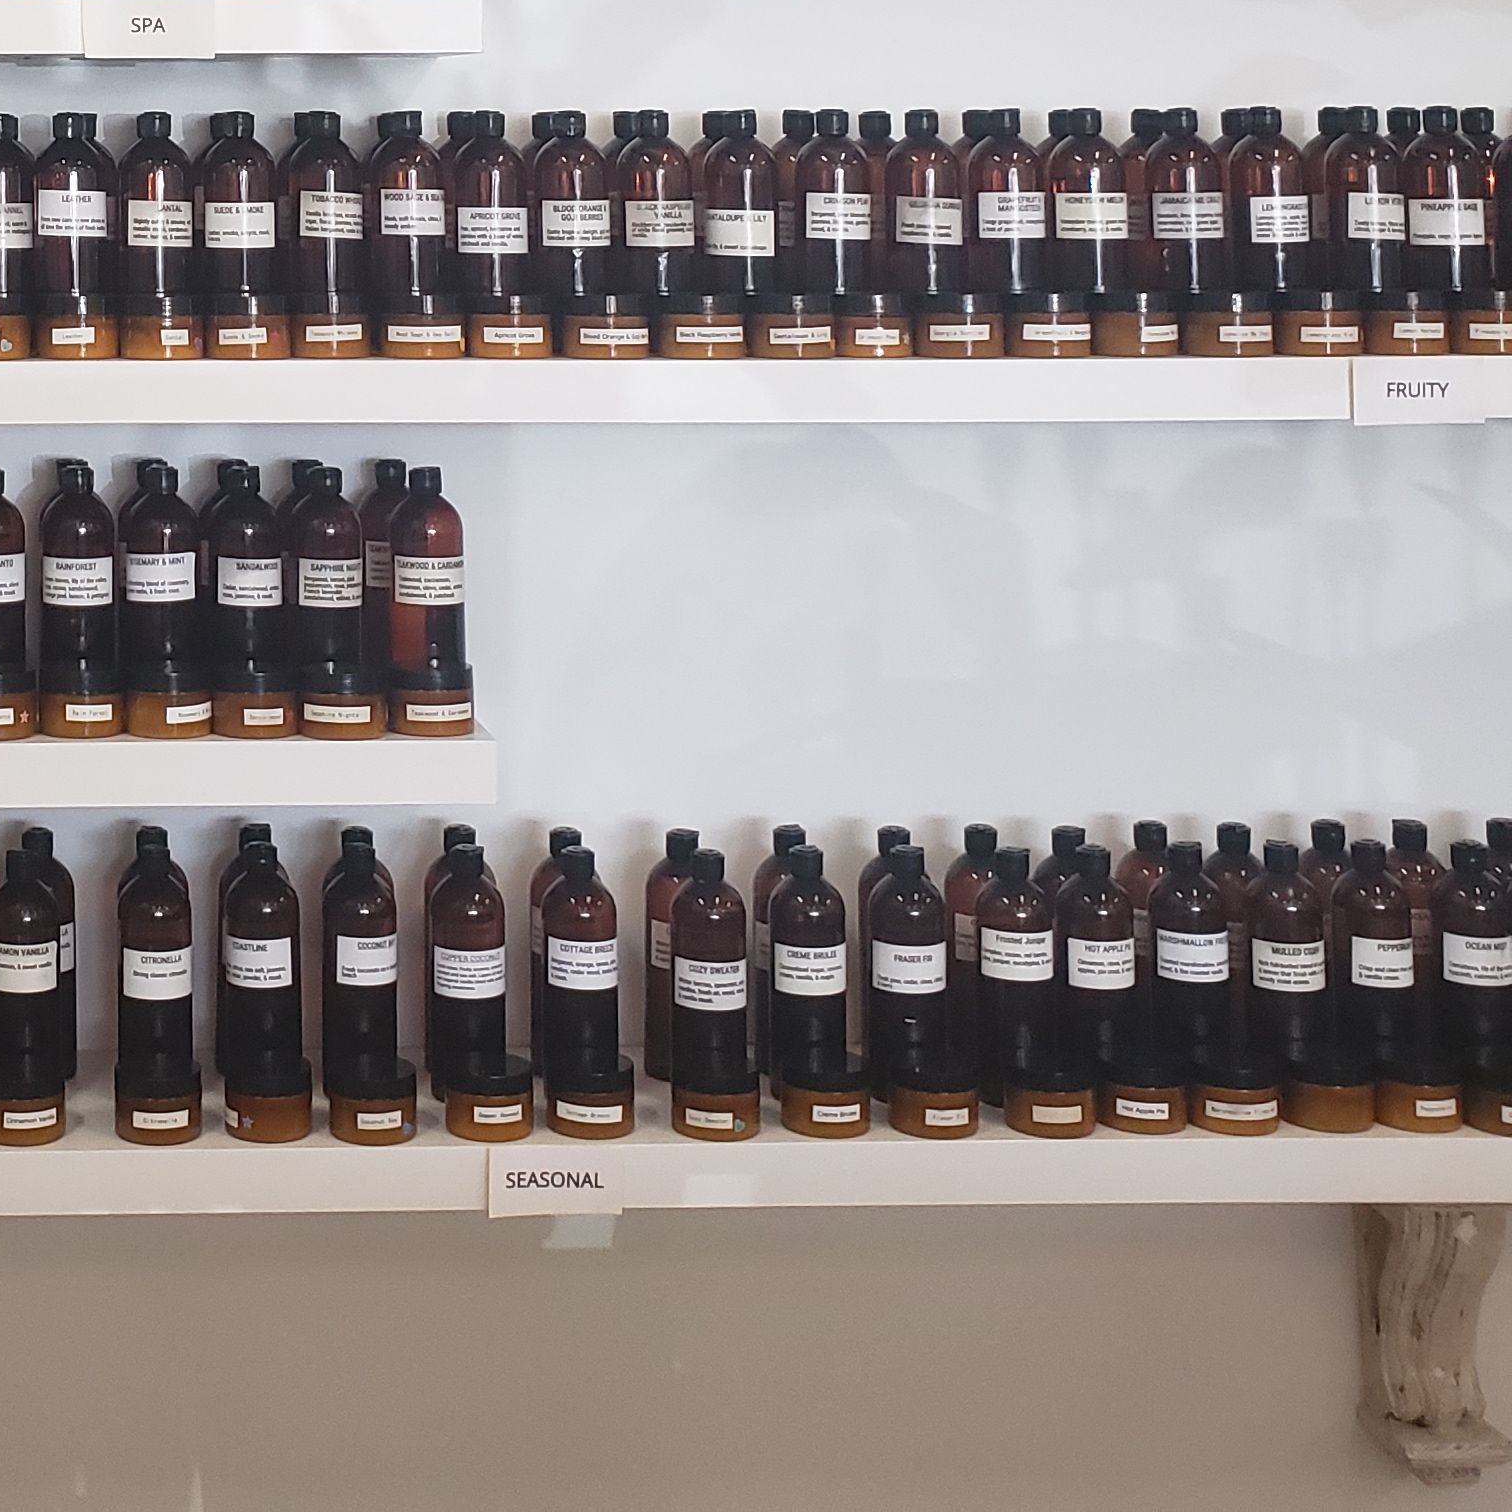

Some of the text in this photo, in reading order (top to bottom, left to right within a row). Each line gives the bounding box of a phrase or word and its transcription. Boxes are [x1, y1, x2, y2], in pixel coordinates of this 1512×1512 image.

[130, 17, 166, 33] SPA
[157, 204, 183, 214] ANTAL
[552, 204, 577, 214] BLOO
[1420, 202, 1463, 212] PINEAPPE
[705, 212, 746, 223] NTALOUPE
[1386, 381, 1450, 398] FRUITY
[21, 945, 50, 957] VANILLA
[559, 943, 594, 955] COTTAGE
[505, 1171, 605, 1189] SEASONAL
